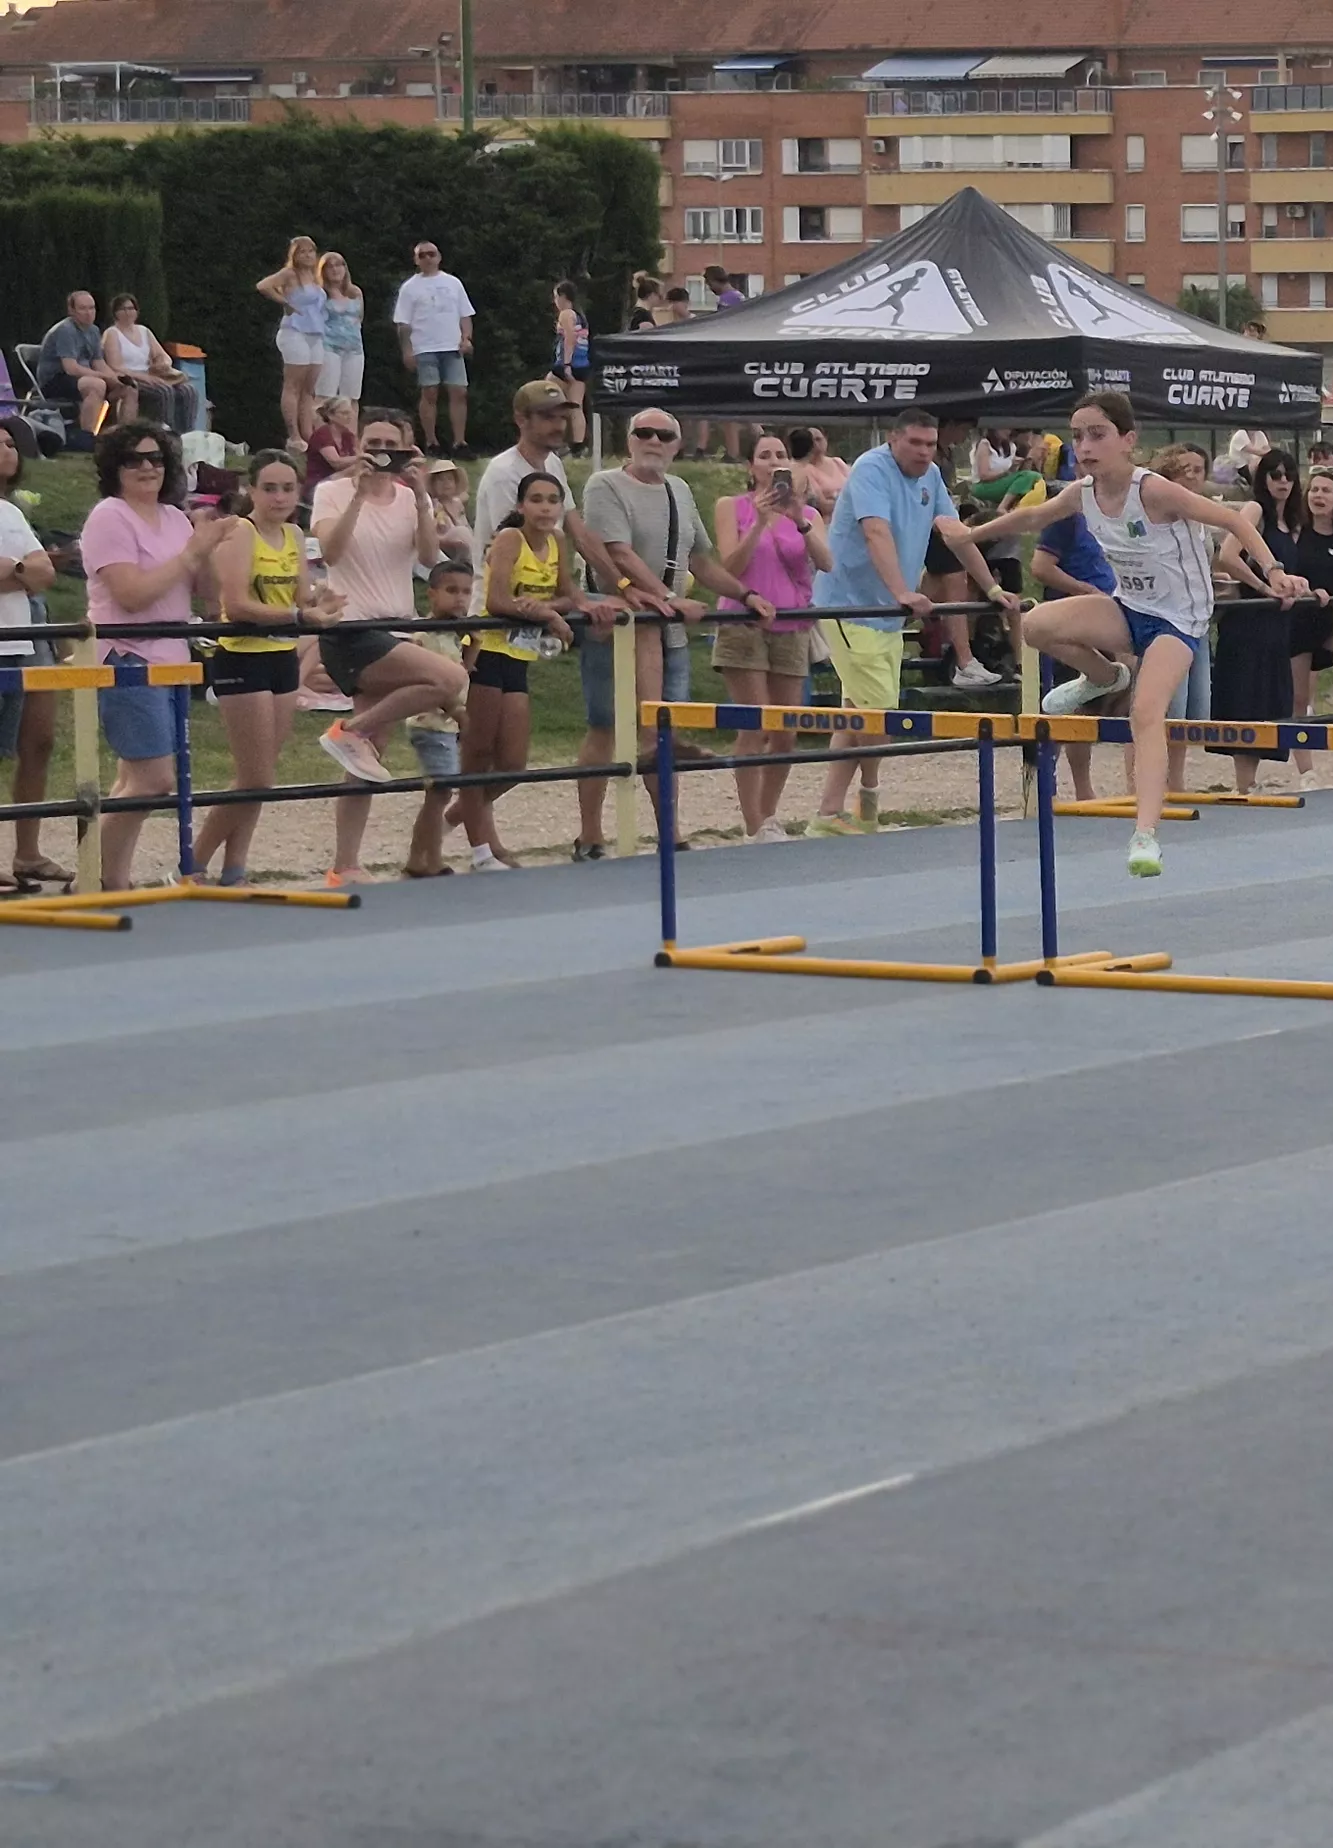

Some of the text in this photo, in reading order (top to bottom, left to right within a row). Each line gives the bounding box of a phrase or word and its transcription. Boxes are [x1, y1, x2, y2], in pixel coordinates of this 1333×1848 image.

[791, 263, 890, 313] CLUB
[744, 362, 931, 376] CLUB ATLETISMO
[1163, 368, 1194, 381] CLUB
[753, 377, 919, 403] CUARTE
[1167, 384, 1249, 411] CUARTE
[782, 712, 865, 731] MONDO
[1169, 724, 1257, 744] MONDO
